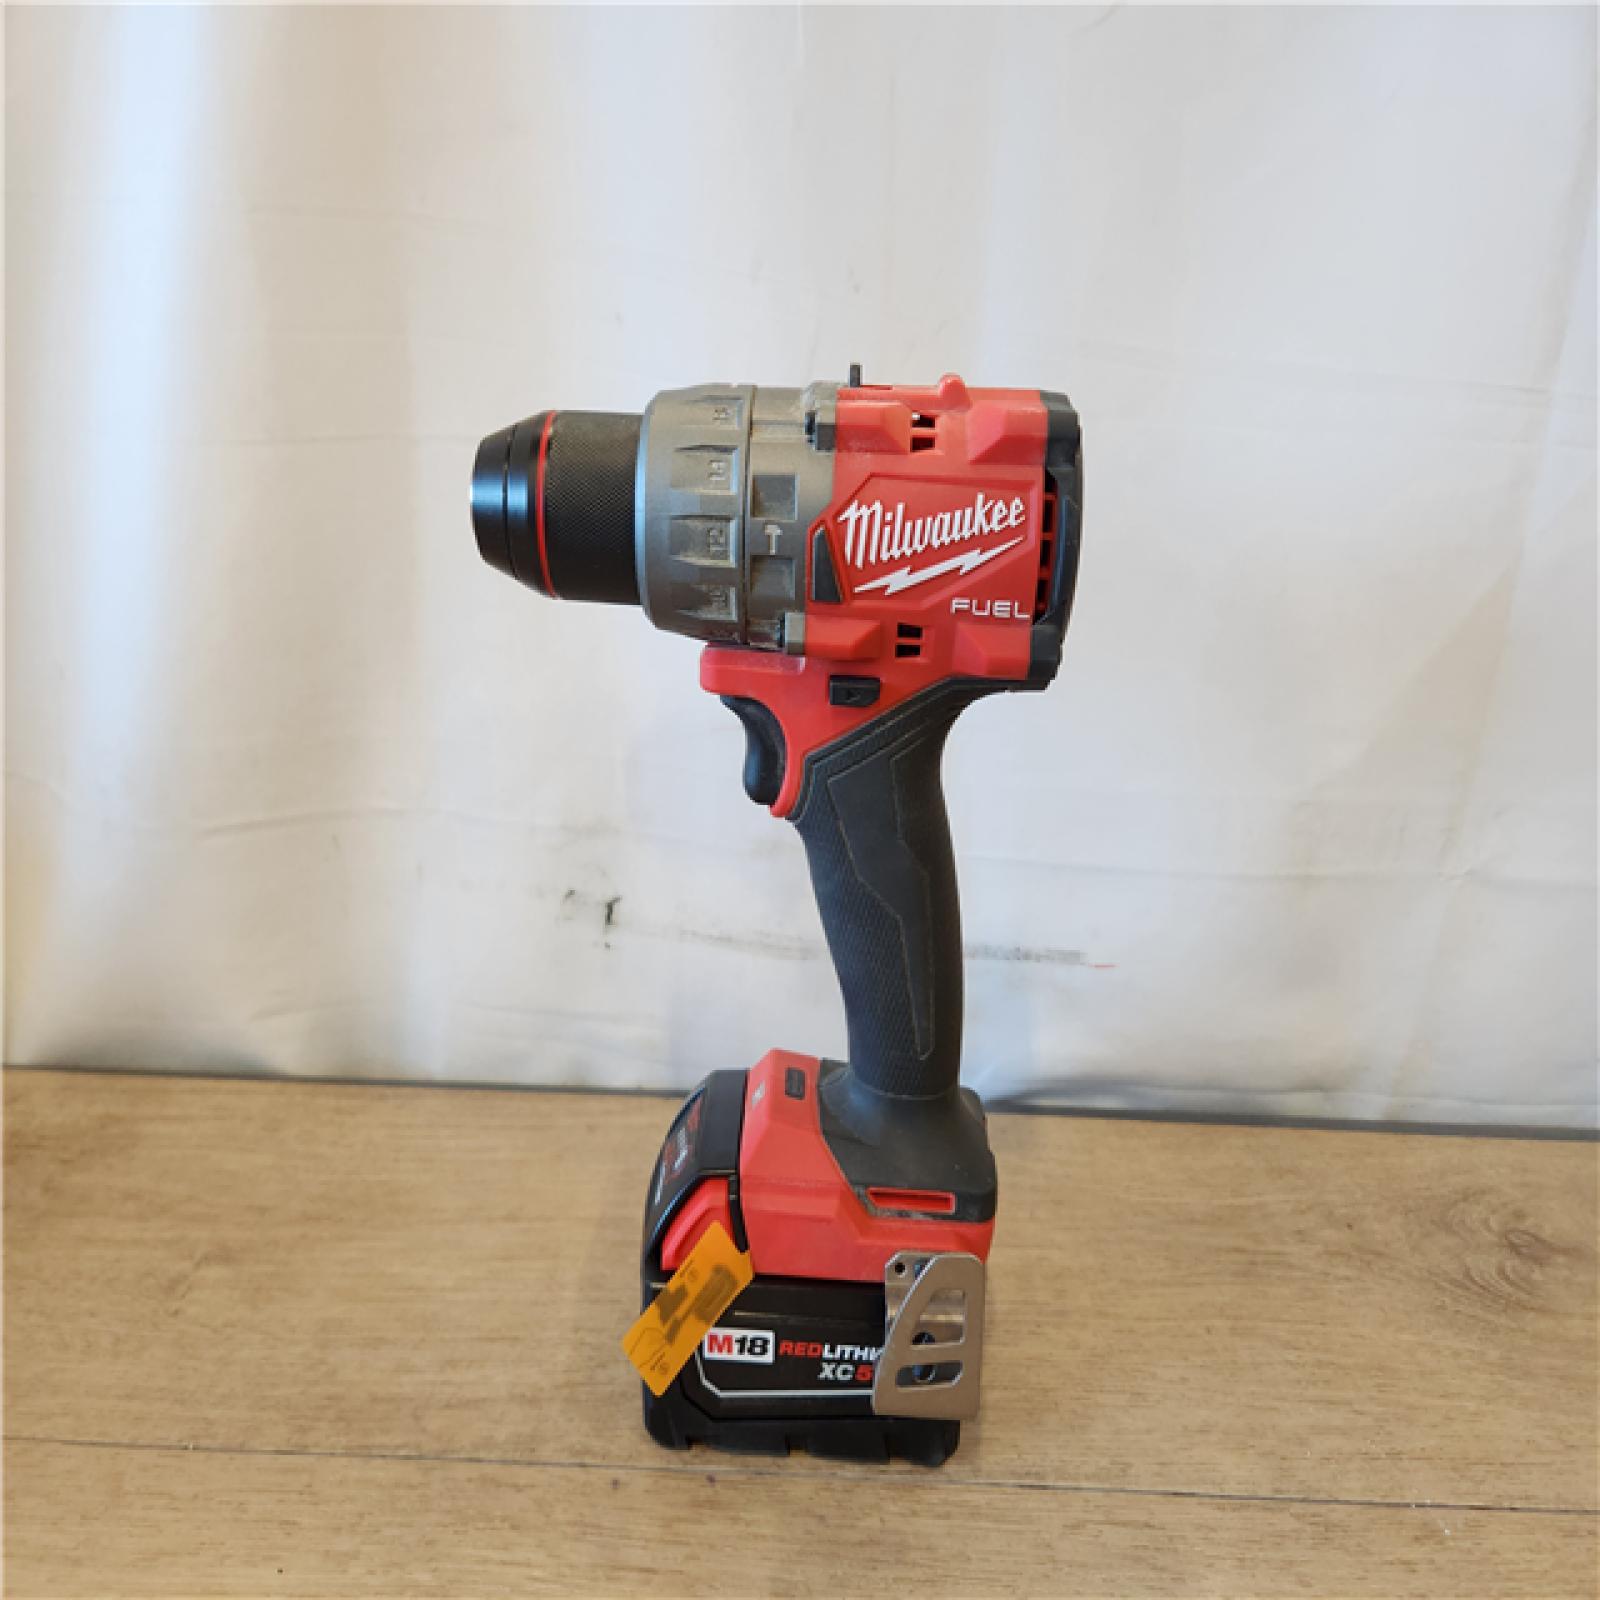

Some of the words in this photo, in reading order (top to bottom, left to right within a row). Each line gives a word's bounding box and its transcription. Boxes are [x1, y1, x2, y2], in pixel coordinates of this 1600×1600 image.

[837, 491, 1026, 569] Milwaukee
[951, 598, 1030, 619] FUEL
[706, 1334, 770, 1356] M18
